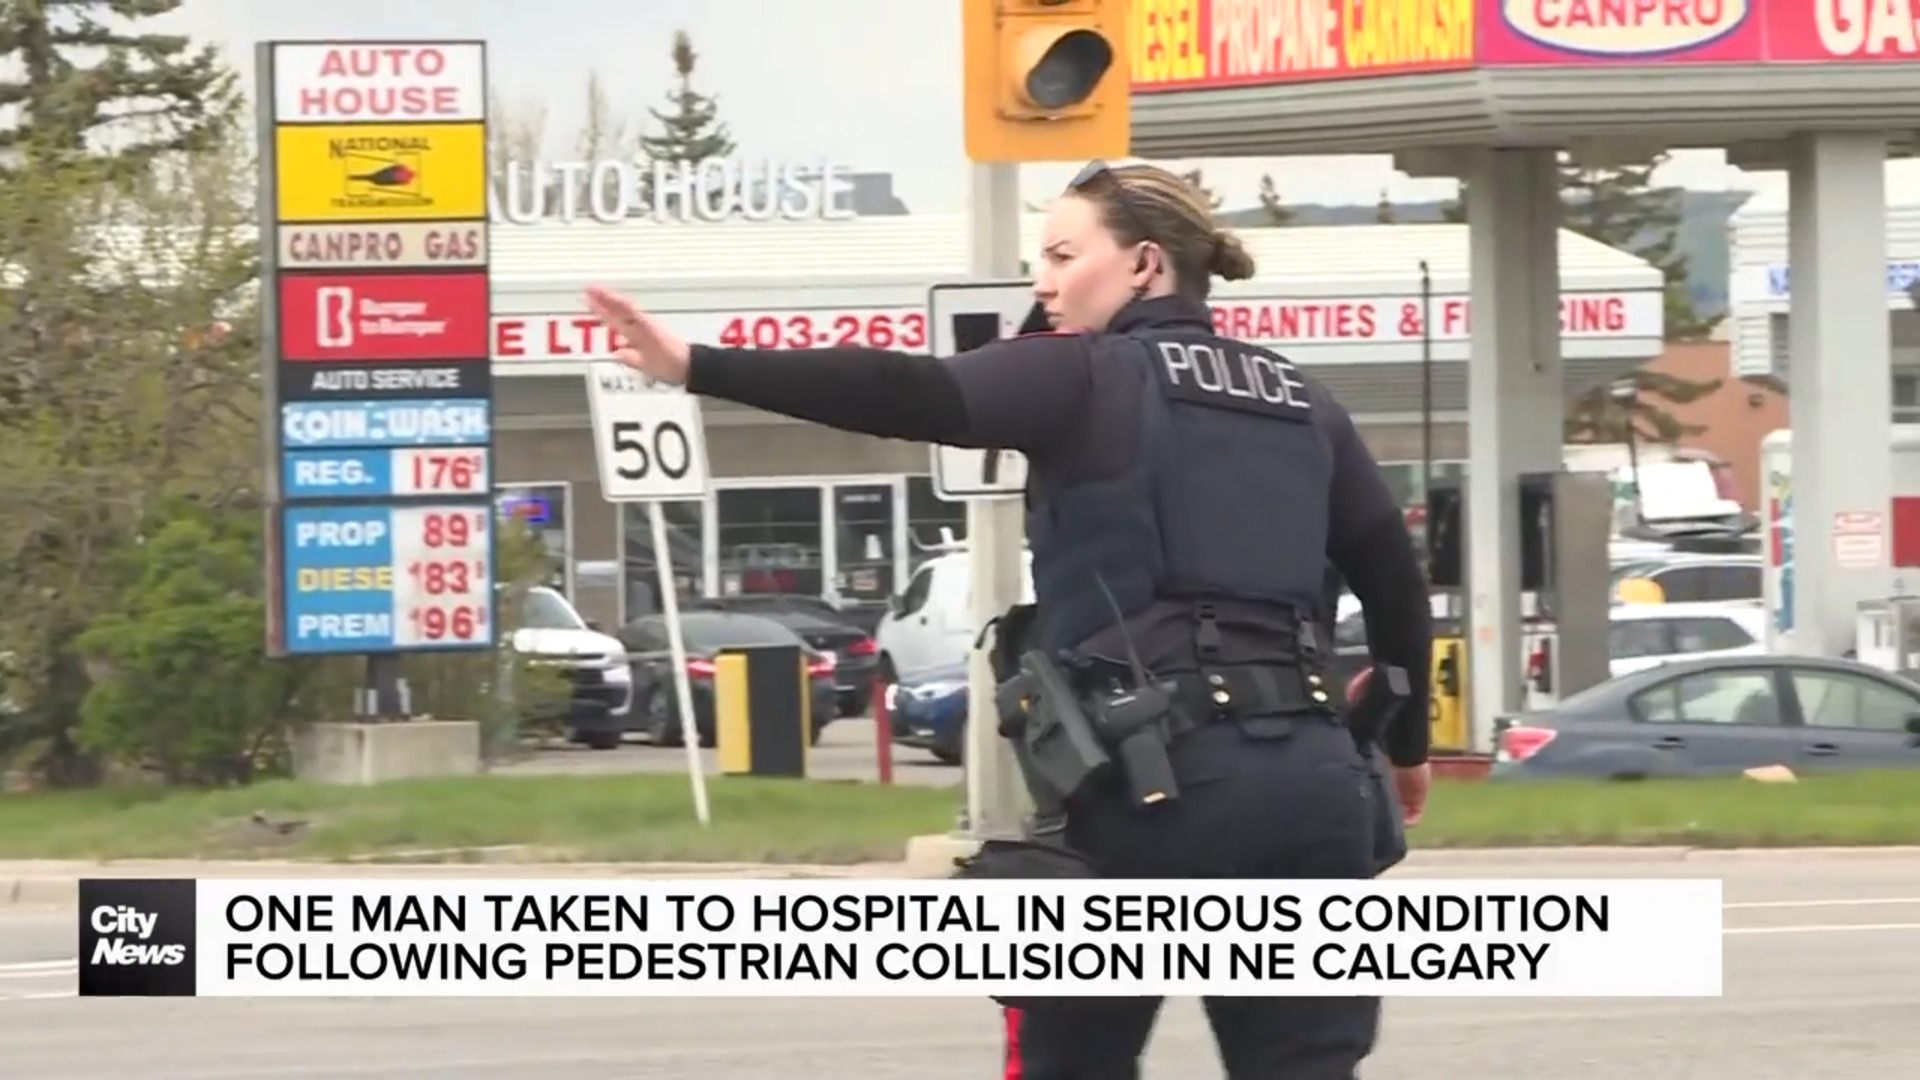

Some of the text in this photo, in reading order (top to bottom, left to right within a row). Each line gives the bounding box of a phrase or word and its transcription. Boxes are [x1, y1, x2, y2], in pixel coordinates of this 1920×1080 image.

[1533, 0, 1725, 28] CANPRO
[1815, 0, 1920, 56] GA
[1209, 0, 1339, 78] PROPANE
[1343, 0, 1473, 68] CARWASH
[320, 48, 446, 77] AUTO
[299, 86, 460, 115] HOUSE
[329, 136, 432, 158] NATIONAL
[652, 156, 856, 223] HOUSE
[289, 230, 478, 262] CANPRO GAS
[1212, 304, 1376, 339] RRANTIES
[1399, 302, 1425, 337] &
[312, 367, 461, 390] AUTO SERVICE
[1158, 341, 1310, 409] POLICE
[612, 420, 692, 481] 50
[295, 459, 376, 486] REG.
[296, 520, 387, 548] PROP
[297, 612, 391, 639] PREM
